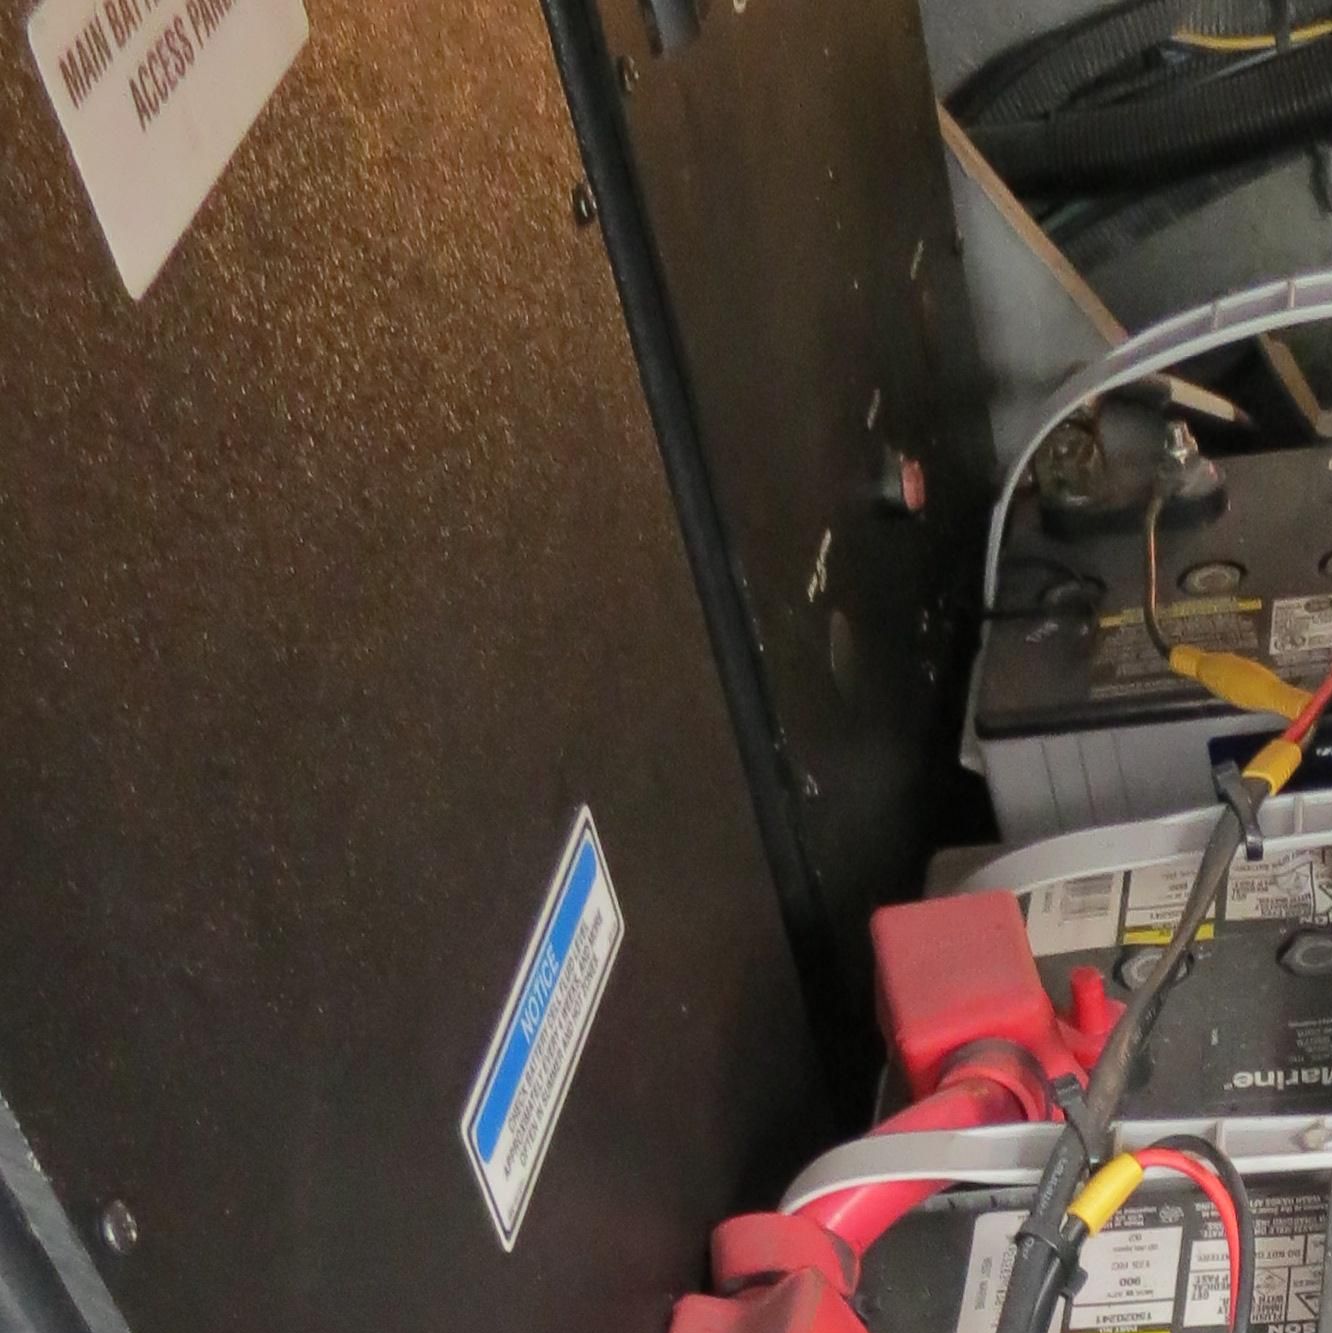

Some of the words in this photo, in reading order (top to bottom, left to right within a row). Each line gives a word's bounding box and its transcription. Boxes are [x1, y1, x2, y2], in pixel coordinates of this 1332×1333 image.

[58, 14, 113, 110] MAIN
[129, 15, 195, 132] ACCESS
[521, 946, 559, 1044] NOTICE
[1095, 1311, 1152, 1324] 15020241
[1119, 1276, 1141, 1287] 900
